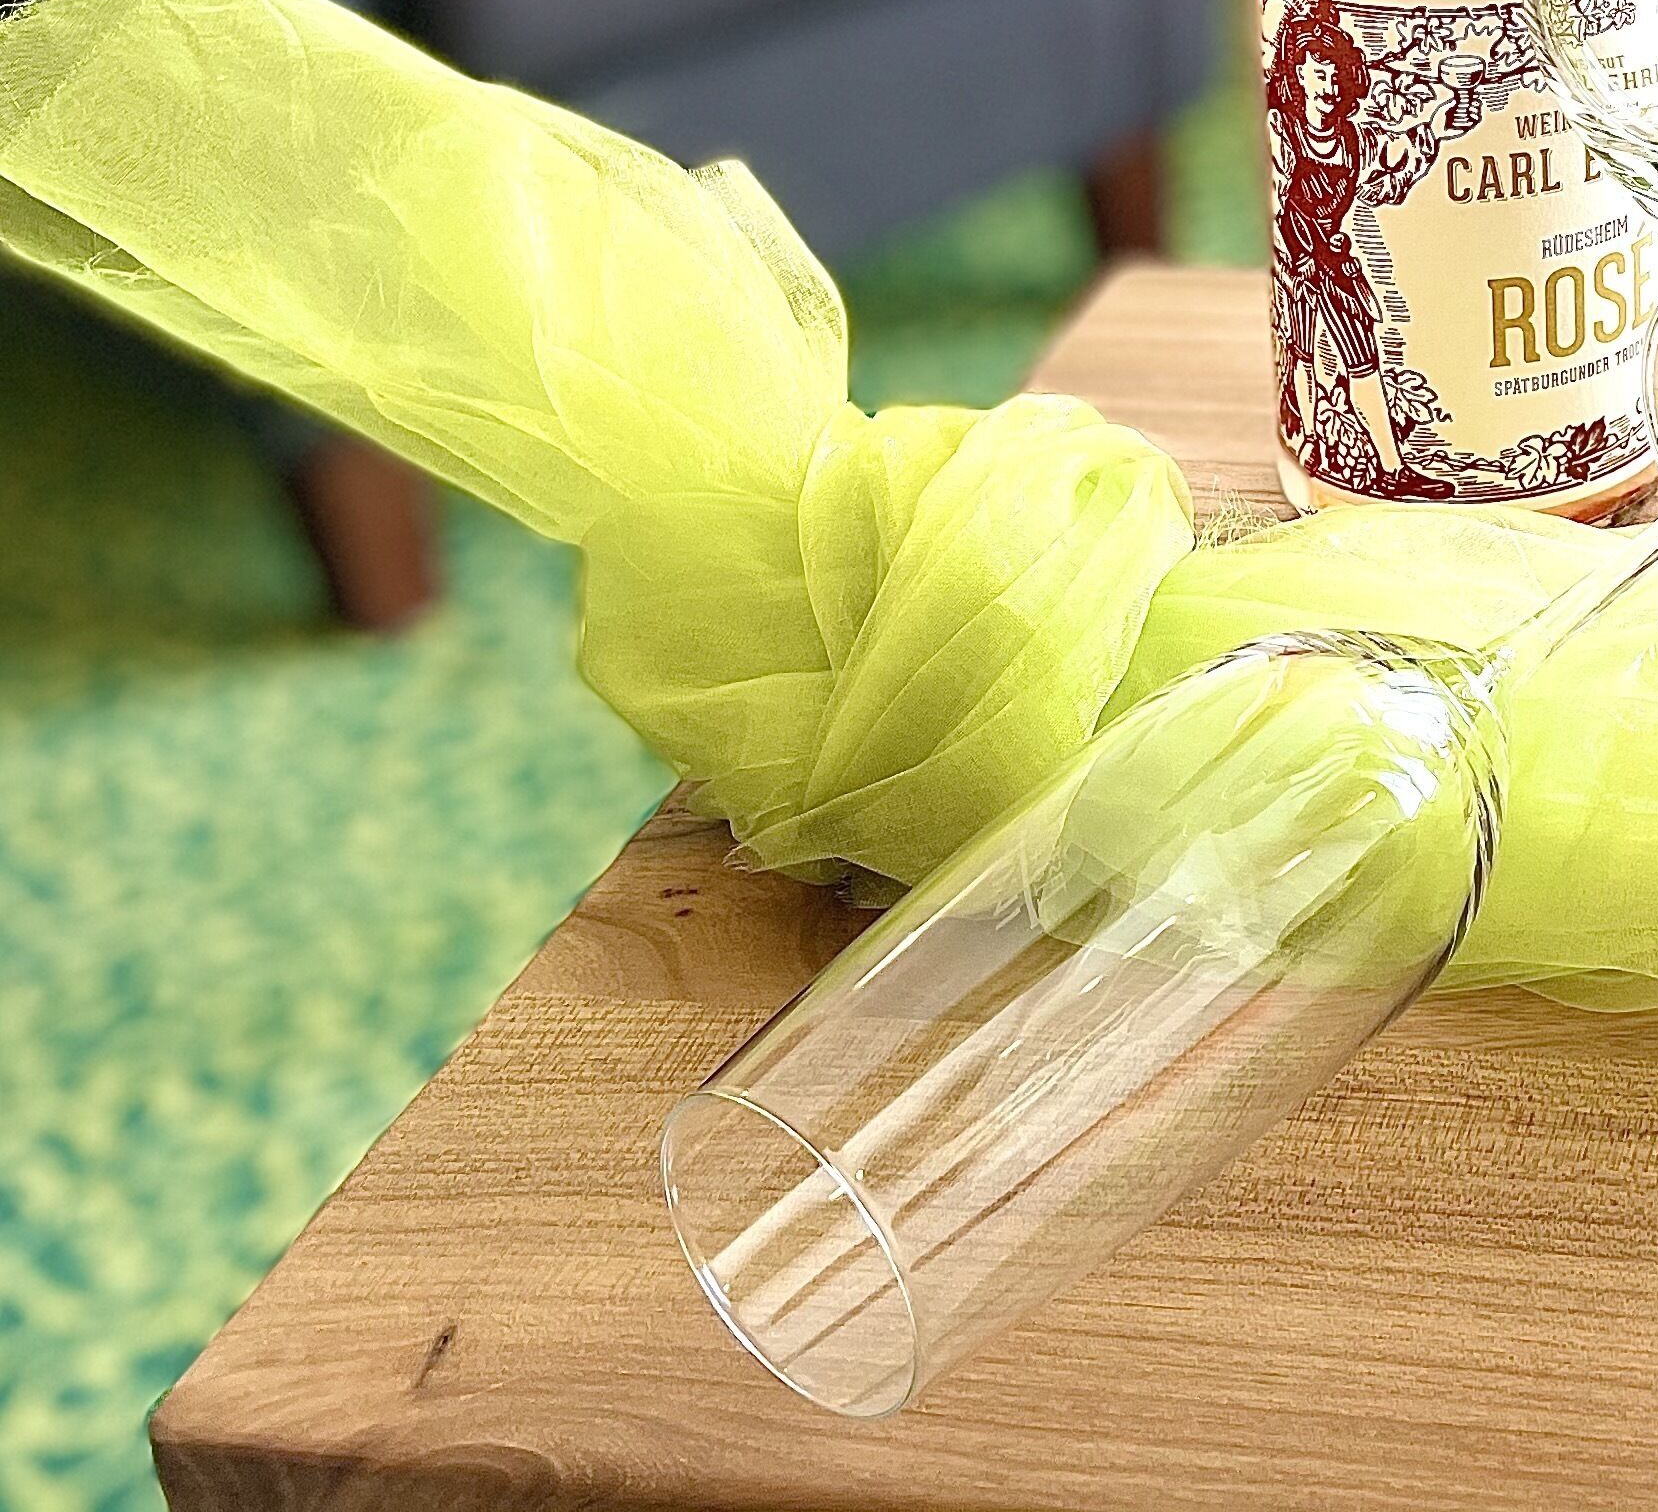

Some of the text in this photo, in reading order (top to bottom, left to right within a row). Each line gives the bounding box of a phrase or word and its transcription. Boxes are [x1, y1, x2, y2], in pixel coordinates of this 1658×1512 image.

[1446, 147, 1563, 203] CARL
[1541, 215, 1629, 260] RÜDESHEIM
[1493, 356, 1610, 398] SPÄTBURGUNDER
